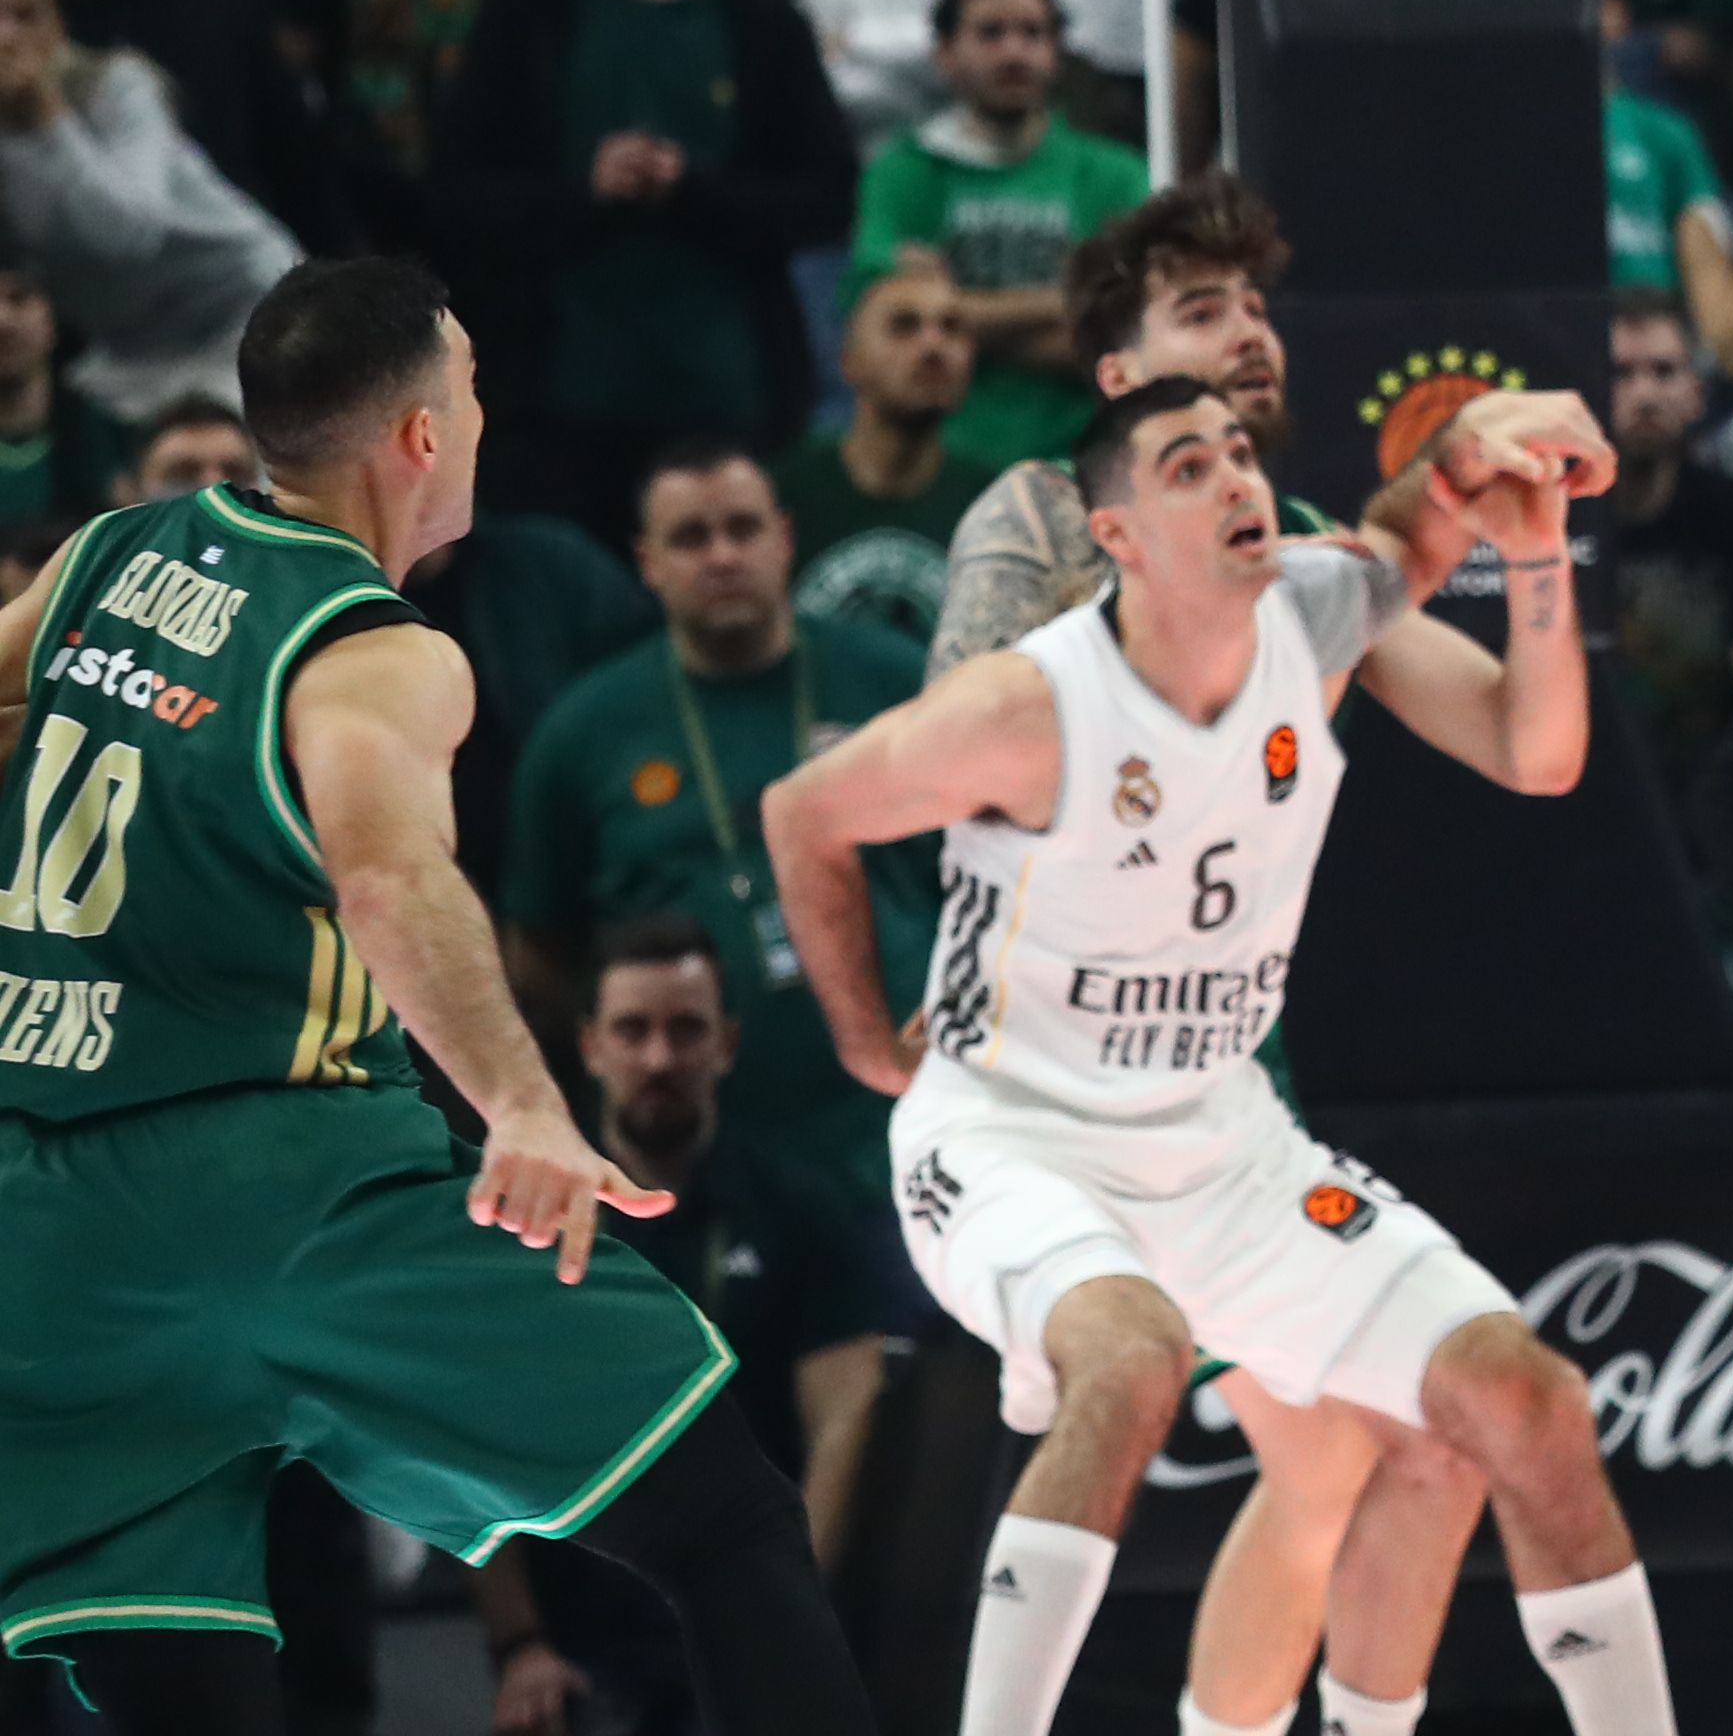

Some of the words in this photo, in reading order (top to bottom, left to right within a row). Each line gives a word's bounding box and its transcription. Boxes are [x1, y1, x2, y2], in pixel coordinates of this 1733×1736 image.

[0, 714, 142, 938] 10
[1190, 839, 1237, 934] 6
[1099, 1024, 1161, 1070] FLY
